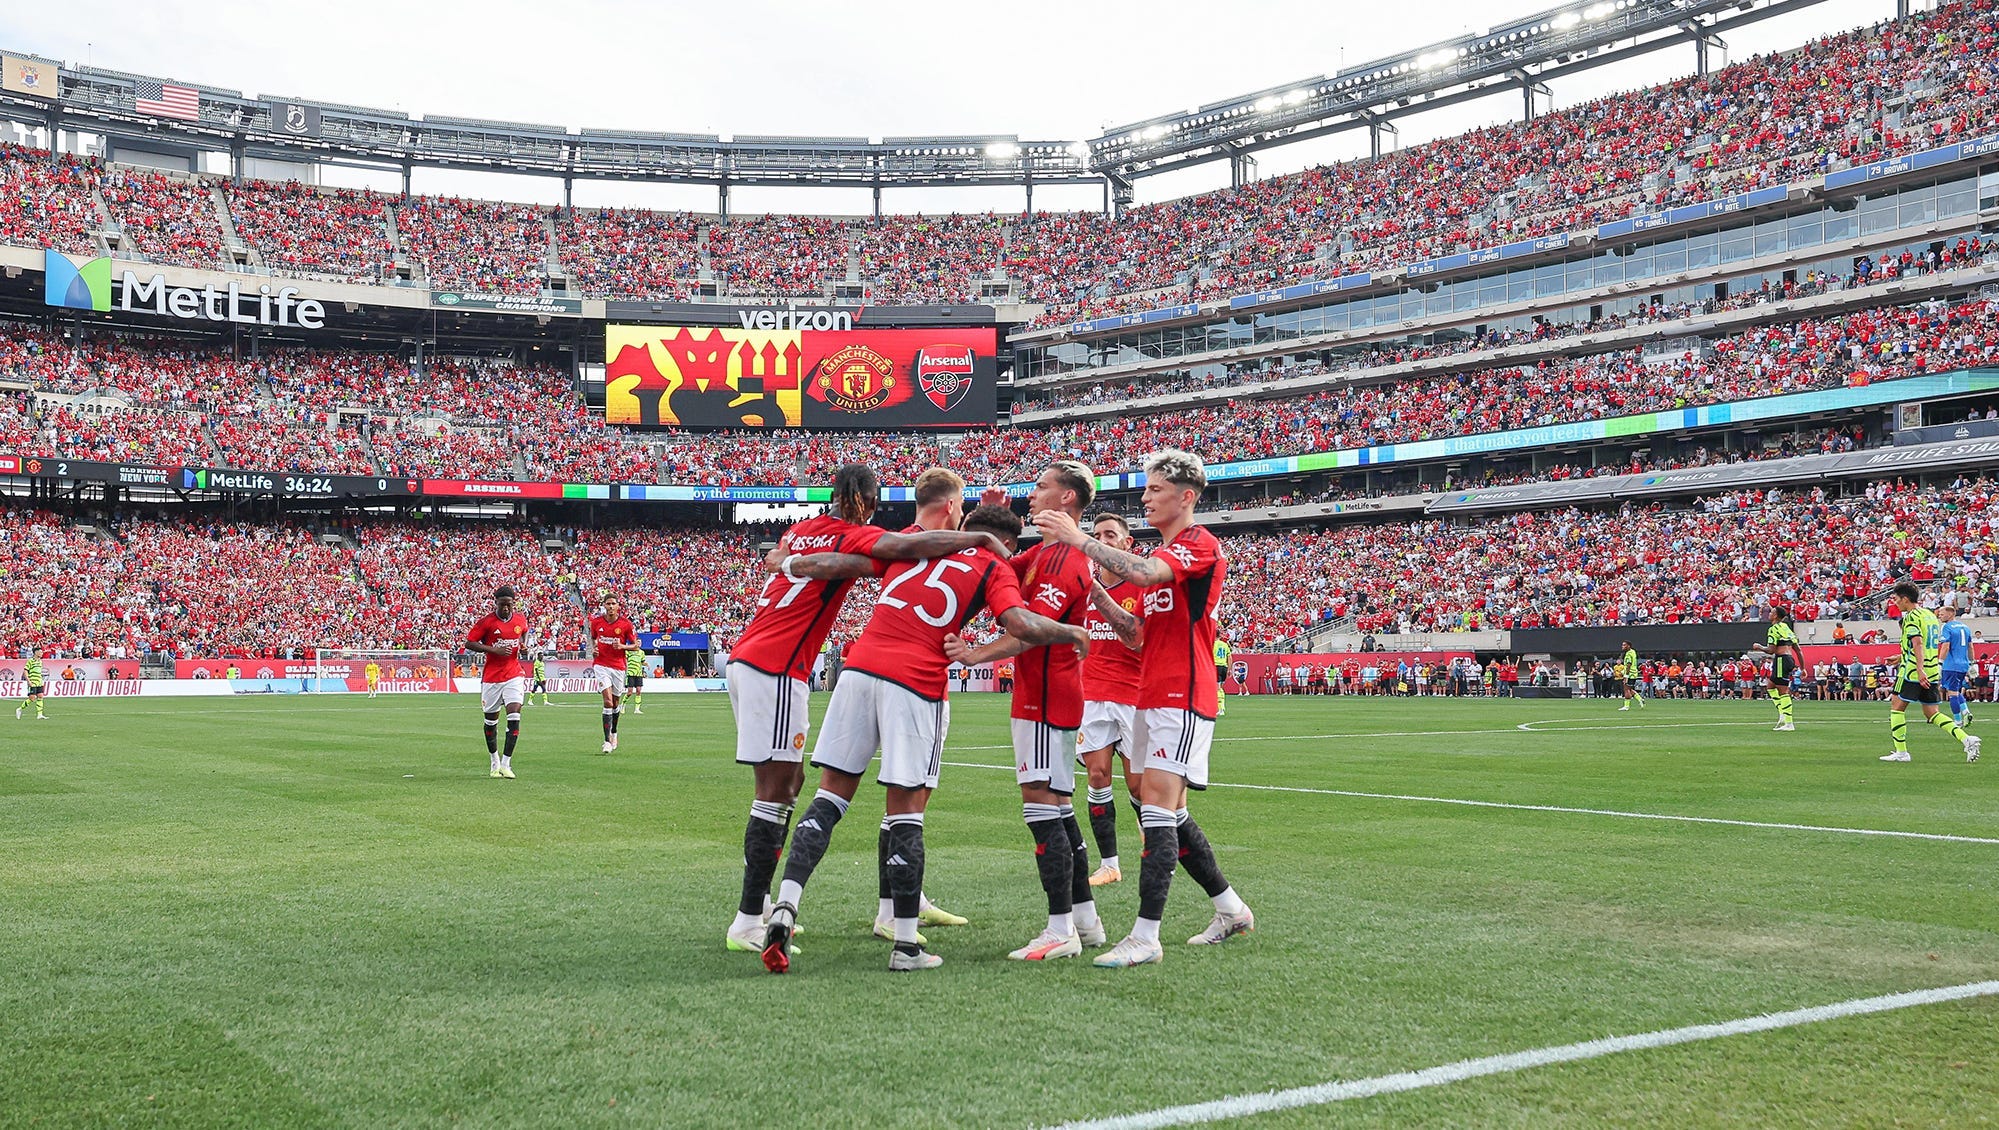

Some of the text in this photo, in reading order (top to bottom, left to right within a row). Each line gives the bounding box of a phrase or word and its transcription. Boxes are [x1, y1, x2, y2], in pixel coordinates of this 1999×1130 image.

[1963, 144, 1974, 154] 20
[1871, 163, 1908, 175] 79 BROWN
[121, 270, 327, 329] MetLife
[463, 293, 502, 303] SUPER
[495, 303, 567, 312] CHAMPIONS
[738, 306, 852, 331] verizon
[827, 350, 888, 373] MANCHESTER
[922, 355, 969, 366] Arsenal
[835, 397, 879, 409] UNITED
[1454, 439, 1480, 452] that
[1484, 433, 1519, 447] make
[1523, 431, 1549, 445] you
[1552, 424, 1578, 439] feel
[1867, 446, 1952, 464] METLIFE
[58, 463, 68, 476] 2
[1204, 464, 1226, 478] ood
[120, 473, 142, 483] NEW
[211, 473, 273, 489] MetLife
[1664, 472, 1718, 483] MetLife
[285, 477, 332, 493] 36:24
[378, 481, 387, 491] 0
[464, 484, 521, 493] ARSENAL
[710, 487, 730, 499] the
[733, 489, 791, 499] moments
[1475, 491, 1520, 501] MetLife
[1345, 503, 1370, 511] MetLife
[877, 557, 973, 628] 25
[652, 639, 680, 648] Corona
[1960, 628, 1966, 647] 1
[1, 681, 22, 697] SEE
[54, 681, 87, 697] SOON
[90, 681, 103, 696] IN
[107, 681, 142, 696] DUBAI
[378, 678, 430, 692] mirates
[546, 679, 560, 692] OU
[562, 679, 585, 692] SOON
